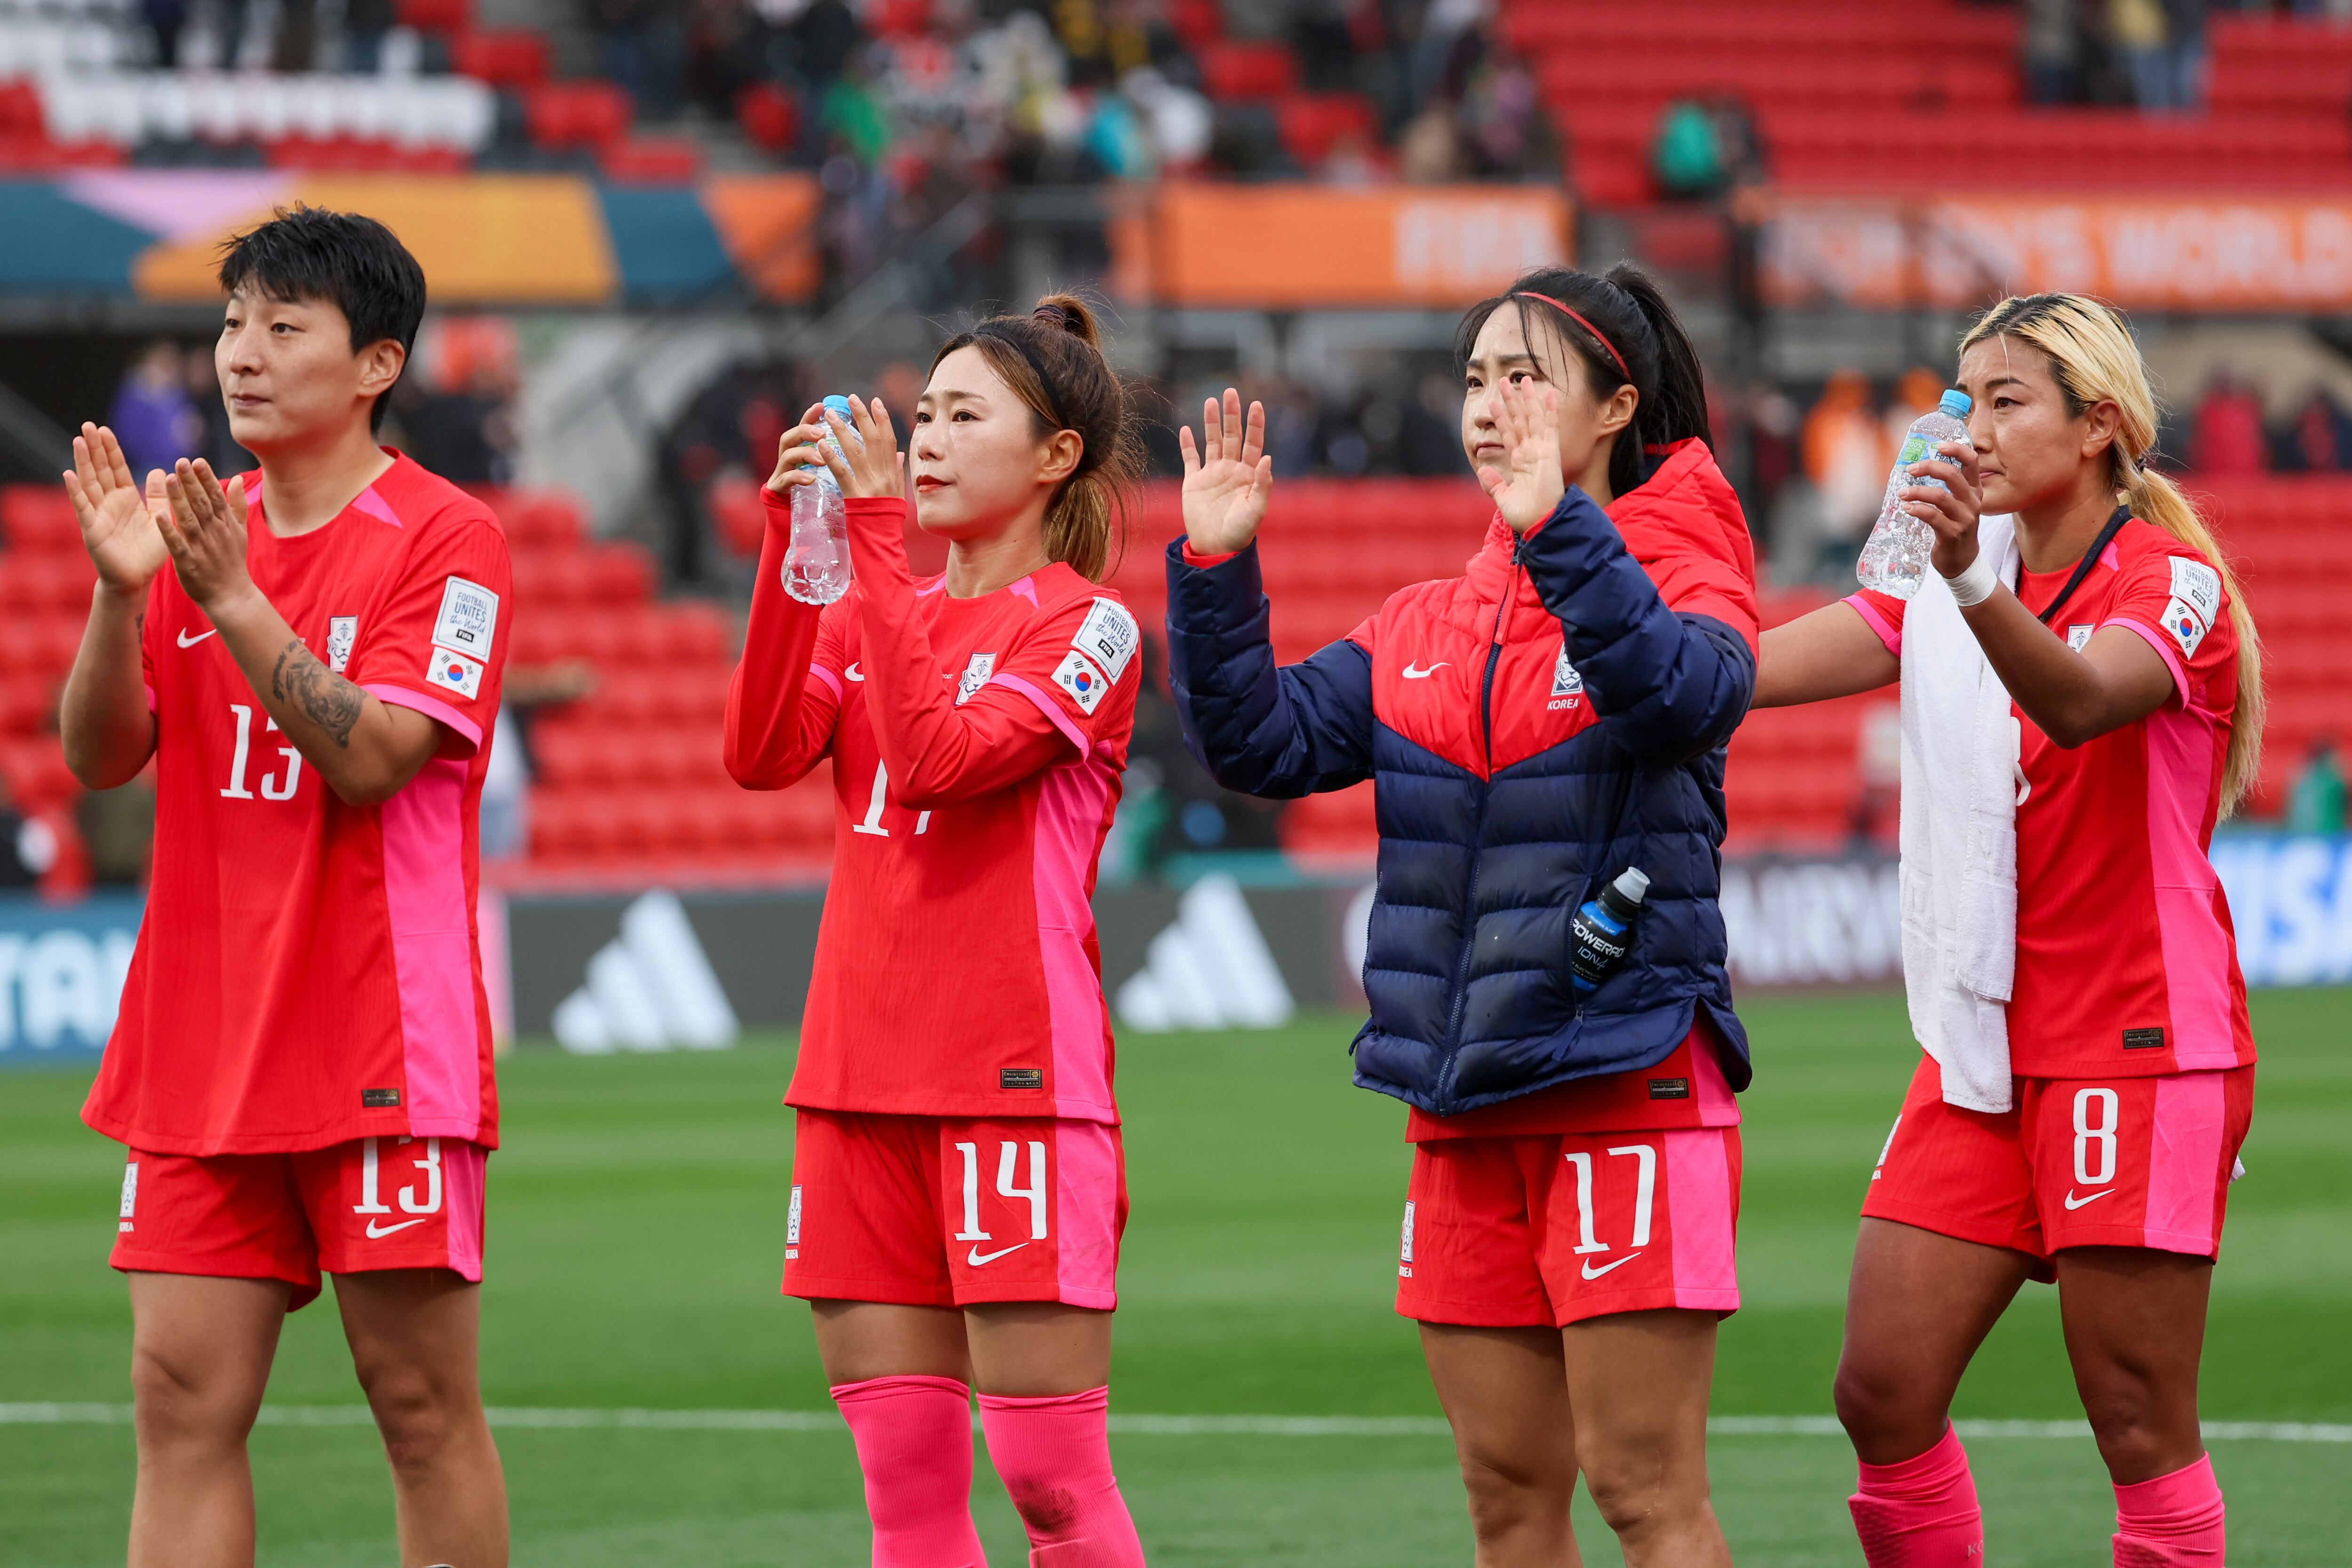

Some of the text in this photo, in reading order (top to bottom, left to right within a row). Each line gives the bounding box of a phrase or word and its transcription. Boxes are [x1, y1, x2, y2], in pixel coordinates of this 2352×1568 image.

[2185, 564, 2213, 586] FOOTBALL
[2186, 569, 2213, 594] UNITES
[457, 592, 487, 610] FOOTBALL
[2183, 578, 2213, 605] the World
[2193, 591, 2204, 605] FIFA
[450, 615, 485, 634] the World
[454, 602, 486, 622] UNITES
[1107, 606, 1132, 635] FOOTBALL
[458, 630, 473, 641] FIFA
[1096, 623, 1126, 655] the World
[1103, 613, 1130, 644] UNITES
[1100, 641, 1112, 656] FIFA
[1547, 698, 1578, 711] KOREA
[220, 704, 302, 800] 13
[852, 758, 931, 837] 1
[2208, 839, 2352, 983] IS
[2073, 1088, 2118, 1184] 8
[353, 1135, 441, 1214] 13
[954, 1141, 1047, 1240] 14
[1565, 1145, 1656, 1254] 17
[1399, 1265, 1413, 1278] REA
